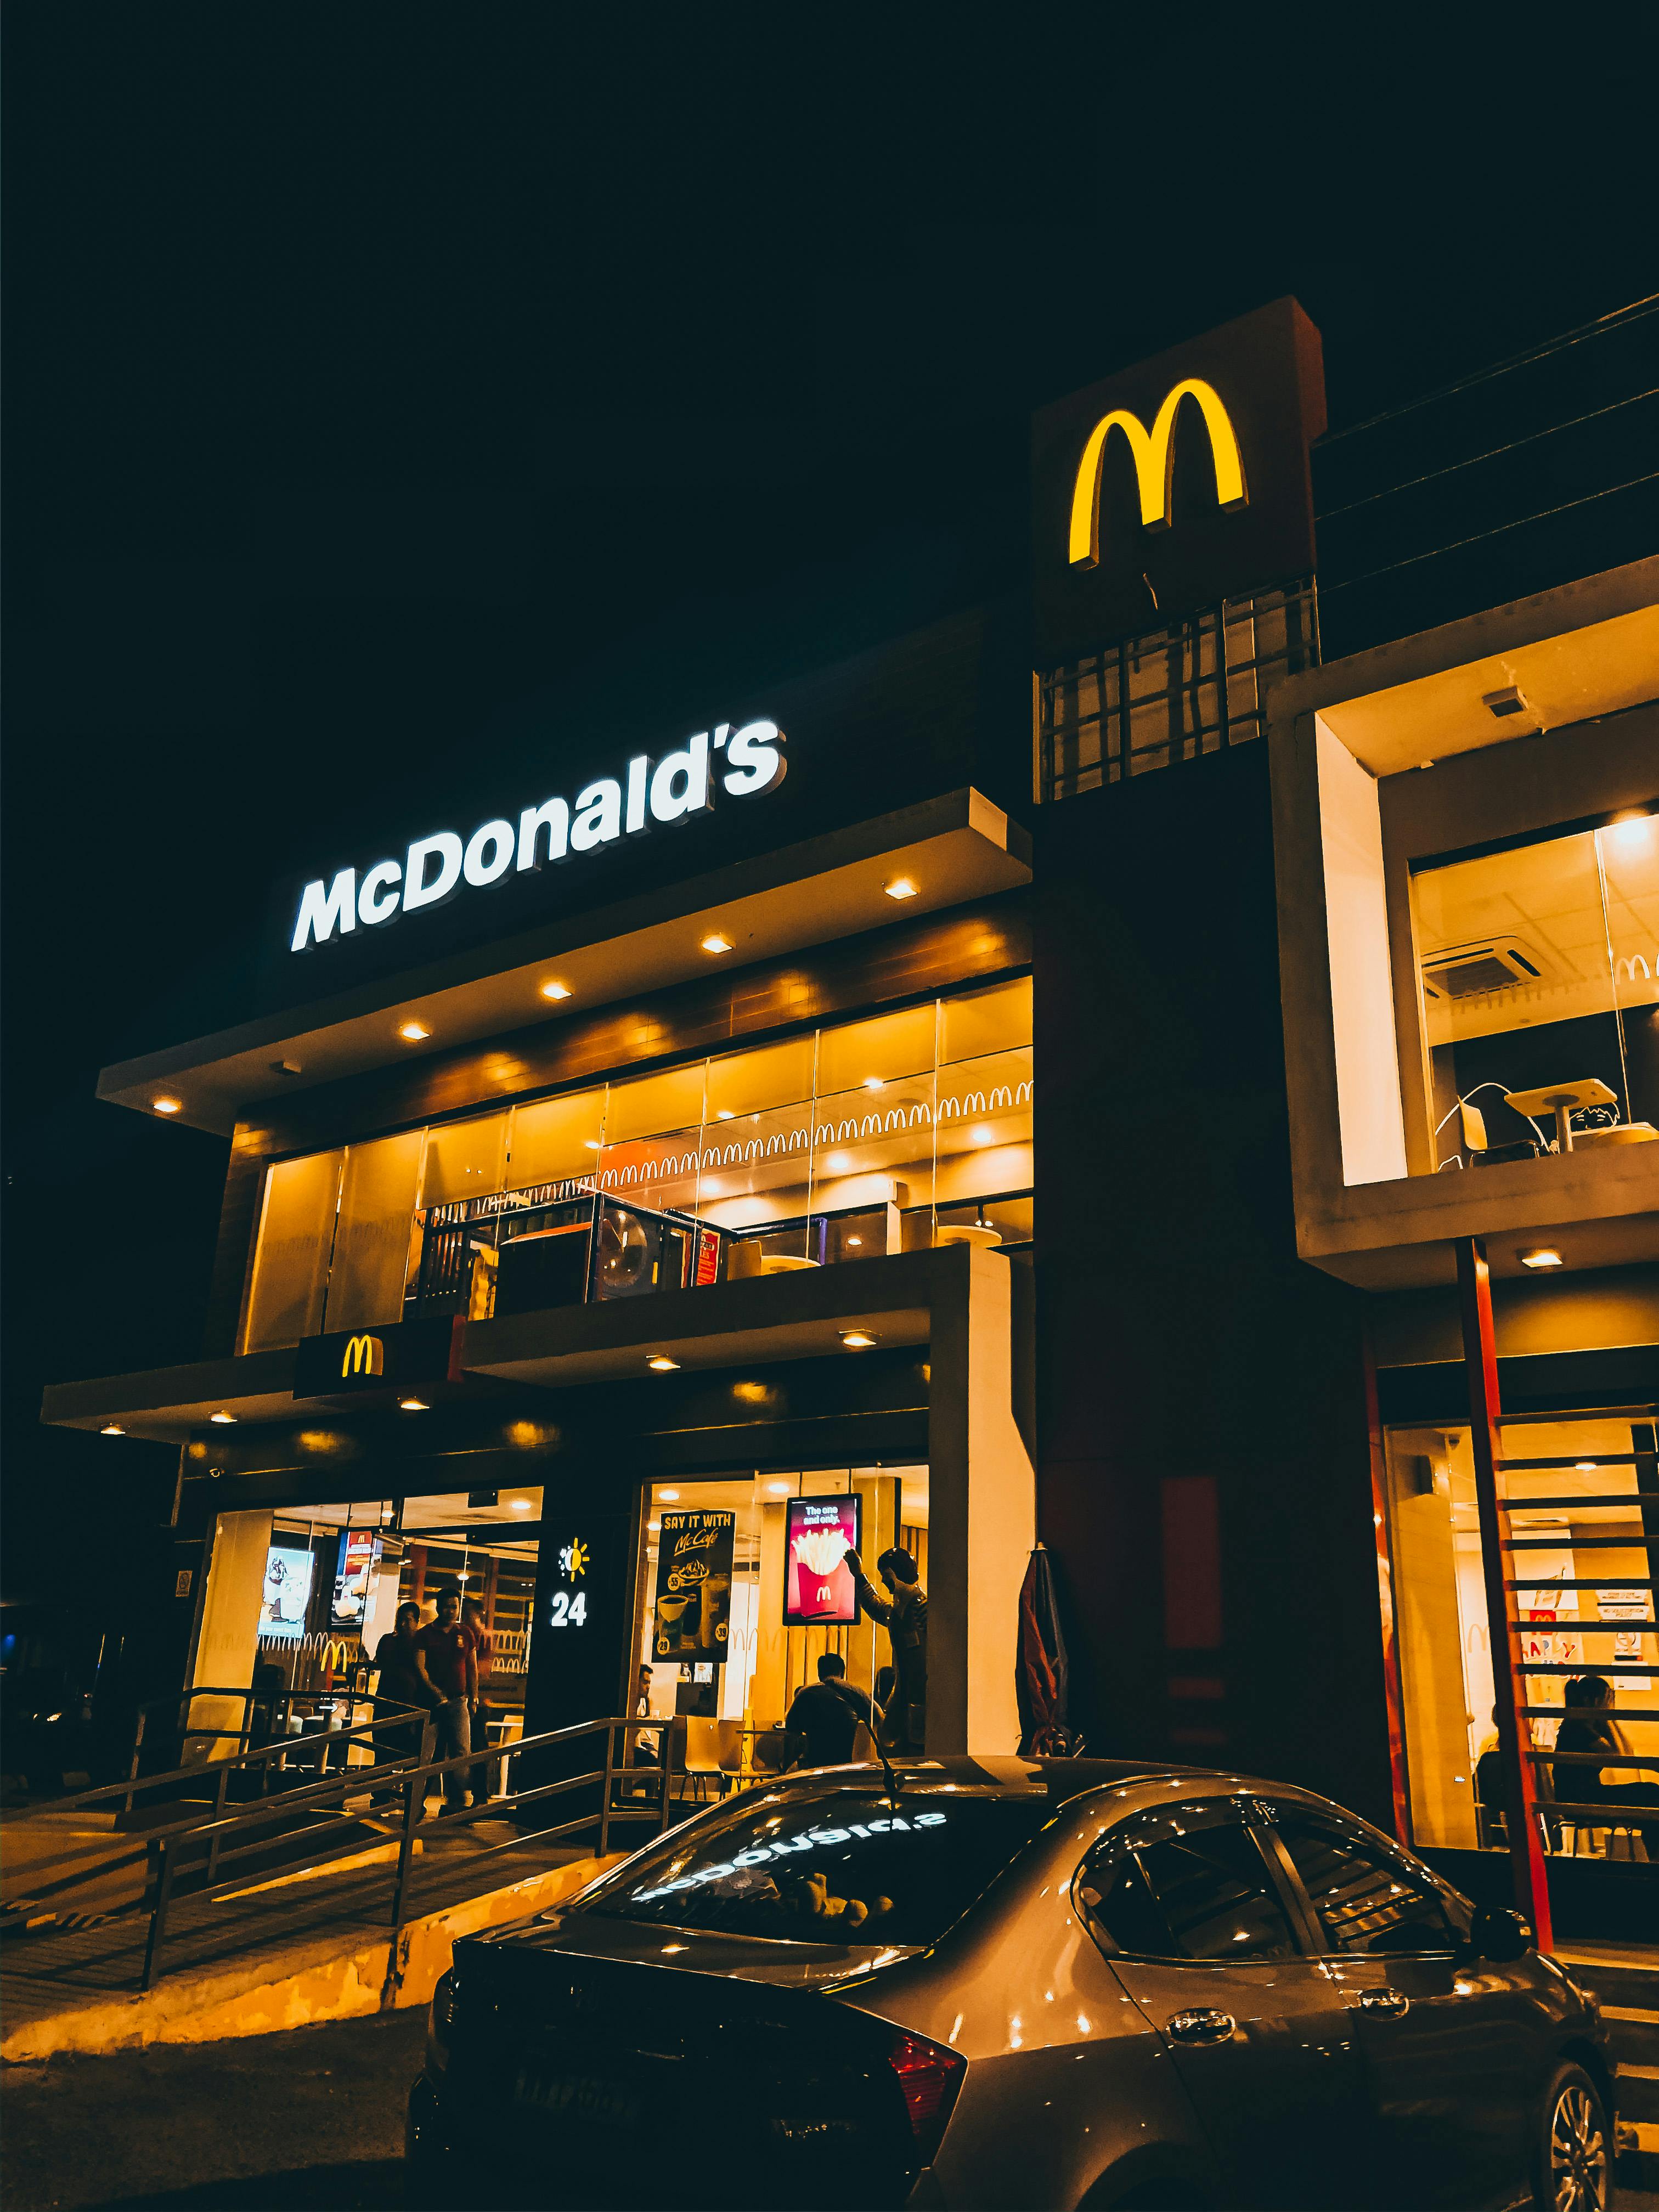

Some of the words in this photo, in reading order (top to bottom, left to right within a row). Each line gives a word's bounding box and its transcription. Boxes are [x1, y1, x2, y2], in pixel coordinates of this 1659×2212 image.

[291, 720, 782, 952] McDonald's
[805, 1506, 821, 1515] The
[664, 1516, 685, 1530] SAY
[689, 1515, 700, 1528] IT
[703, 1514, 731, 1527] WITH
[803, 1515, 820, 1525] and
[820, 1514, 840, 1525] only.
[551, 1592, 587, 1627] 24
